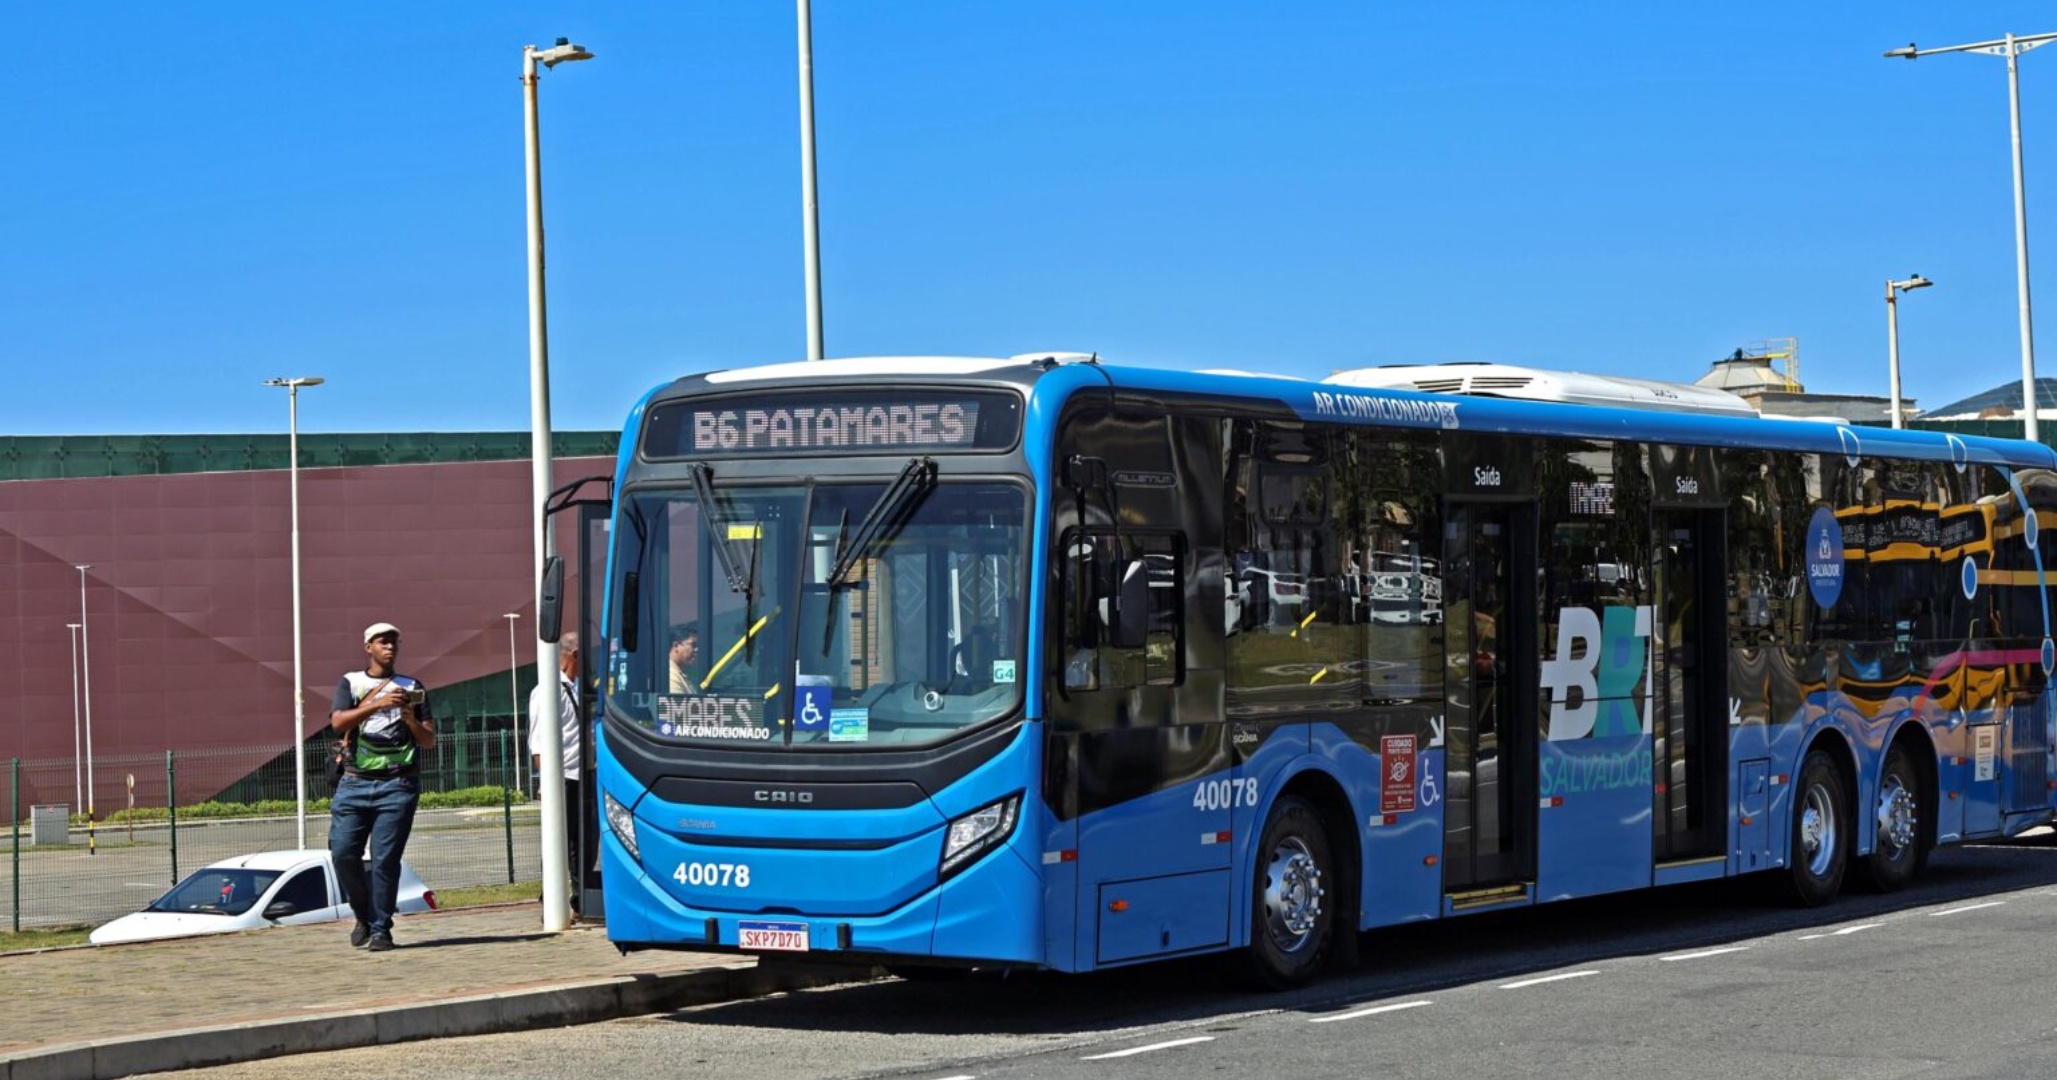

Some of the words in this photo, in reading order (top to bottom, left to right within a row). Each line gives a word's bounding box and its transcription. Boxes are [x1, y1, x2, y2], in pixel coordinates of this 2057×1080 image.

[1313, 391, 1336, 415] AR
[1336, 393, 1443, 423] CONDICIONADO
[694, 411, 739, 449] B6
[745, 404, 964, 447] PATAMARES
[1474, 464, 1501, 486] Saída
[1675, 475, 1698, 494] Saída
[1811, 563, 1840, 577] SALVADOR
[994, 668, 1015, 680] G4
[675, 725, 690, 737] AR
[690, 725, 770, 740] CONDICIONADO
[1540, 750, 1653, 795] SALVADOR
[754, 790, 814, 803] CAIO
[1193, 777, 1258, 812] 40078
[673, 862, 751, 888] 40078
